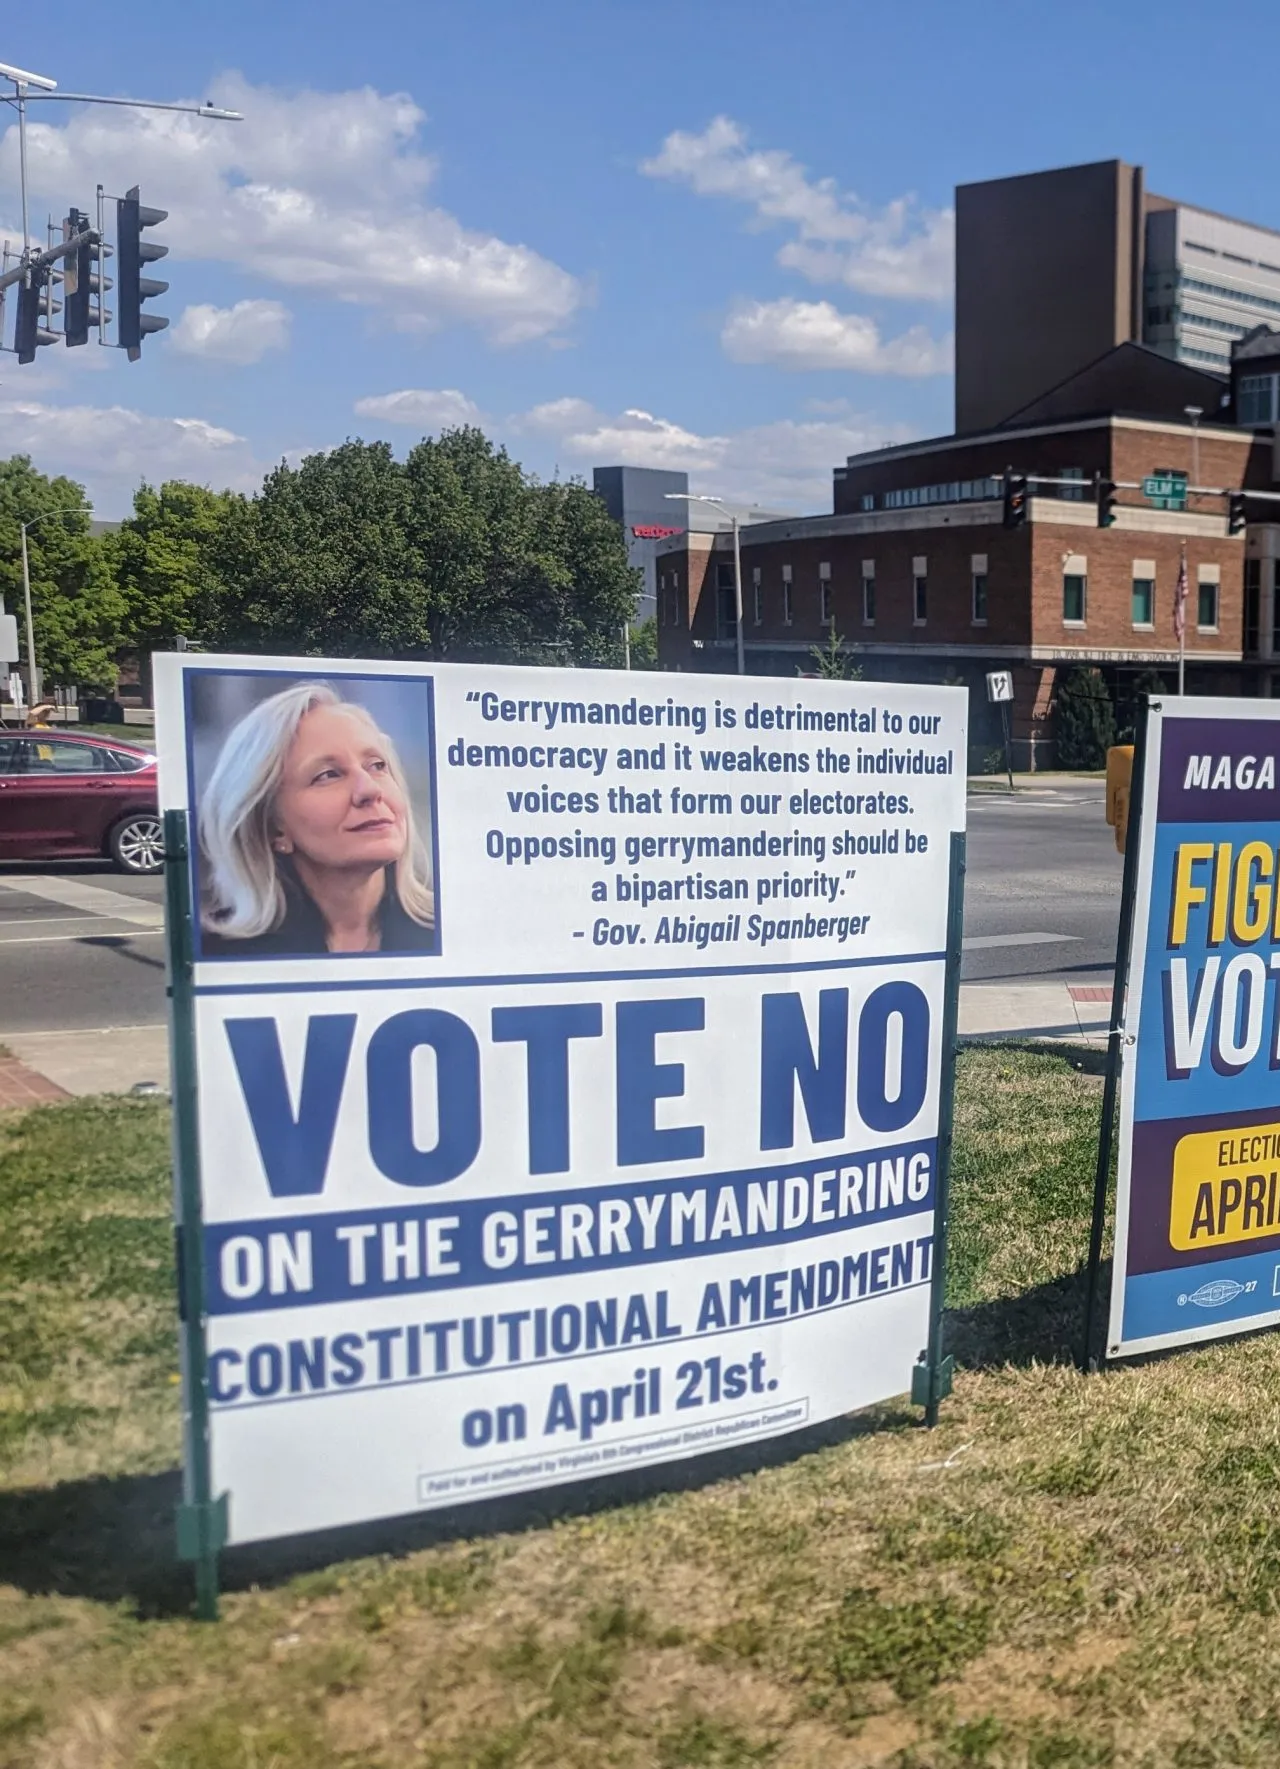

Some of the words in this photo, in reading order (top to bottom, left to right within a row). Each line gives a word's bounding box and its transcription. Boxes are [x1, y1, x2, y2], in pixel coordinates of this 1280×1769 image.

[1147, 480, 1172, 495] ELM
[466, 692, 706, 734] “Gerrymandering
[715, 700, 736, 728] is
[745, 703, 876, 733] detrimental
[882, 711, 901, 734] to
[908, 716, 941, 735] our
[448, 739, 606, 775] democracy
[616, 743, 665, 771] and
[674, 744, 692, 771] it
[700, 746, 810, 773] weakens
[816, 747, 850, 773] the
[857, 749, 953, 775] individual
[1184, 755, 1275, 790] MAGA
[507, 784, 599, 813] voices
[607, 786, 662, 813] that
[670, 787, 731, 813] form
[740, 792, 782, 814] our
[789, 789, 914, 814] electorates.
[486, 830, 616, 864] Opposing
[624, 832, 825, 864] gerrymandering
[832, 830, 898, 855] should
[905, 829, 928, 853] be
[591, 879, 607, 901] a
[616, 874, 748, 907] bipartisan
[757, 870, 855, 902] priority.”
[592, 918, 646, 945] Gov.
[655, 915, 739, 949] Abigail
[747, 912, 870, 940] Spanberger
[223, 997, 705, 1198] VOTE
[760, 981, 930, 1151] NO
[220, 1231, 313, 1299] ON
[336, 1217, 459, 1286] THE
[482, 1153, 930, 1270] GERRYMANDERING
[1245, 1281, 1257, 1293] 27
[208, 1282, 681, 1402] CONSTITUTIONAL
[696, 1234, 934, 1333] AMENDMENT
[462, 1405, 526, 1448] on
[543, 1367, 661, 1439] April
[674, 1351, 779, 1409] 21st.
